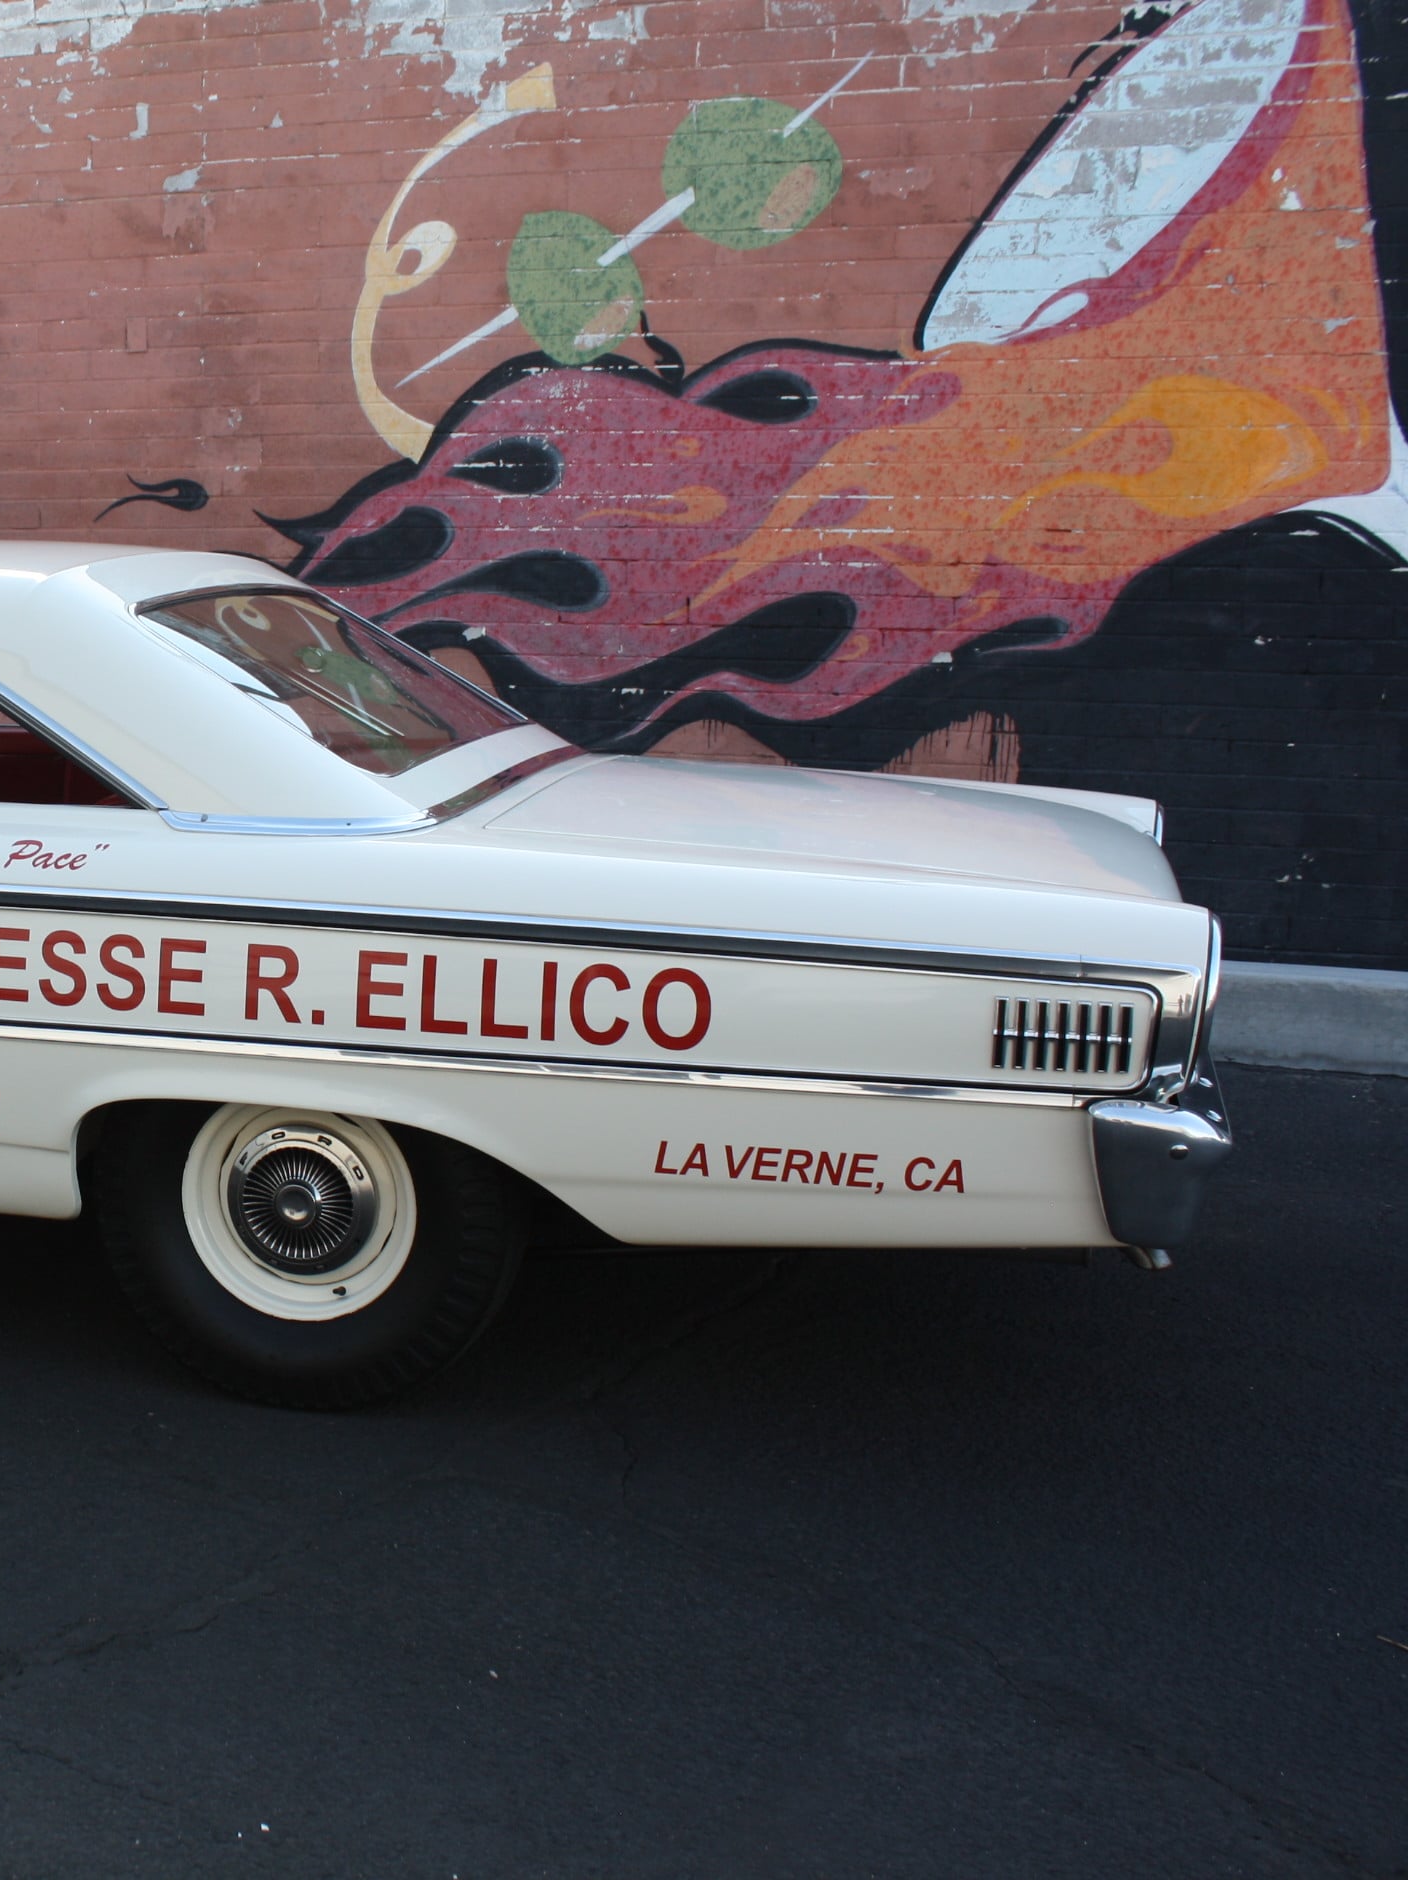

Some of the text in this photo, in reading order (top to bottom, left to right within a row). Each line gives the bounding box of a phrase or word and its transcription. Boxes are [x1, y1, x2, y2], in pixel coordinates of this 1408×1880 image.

[244, 943, 325, 1025] R.
[355, 949, 712, 1051] ELLICO
[653, 1140, 965, 1194] LA VERNE, CA
